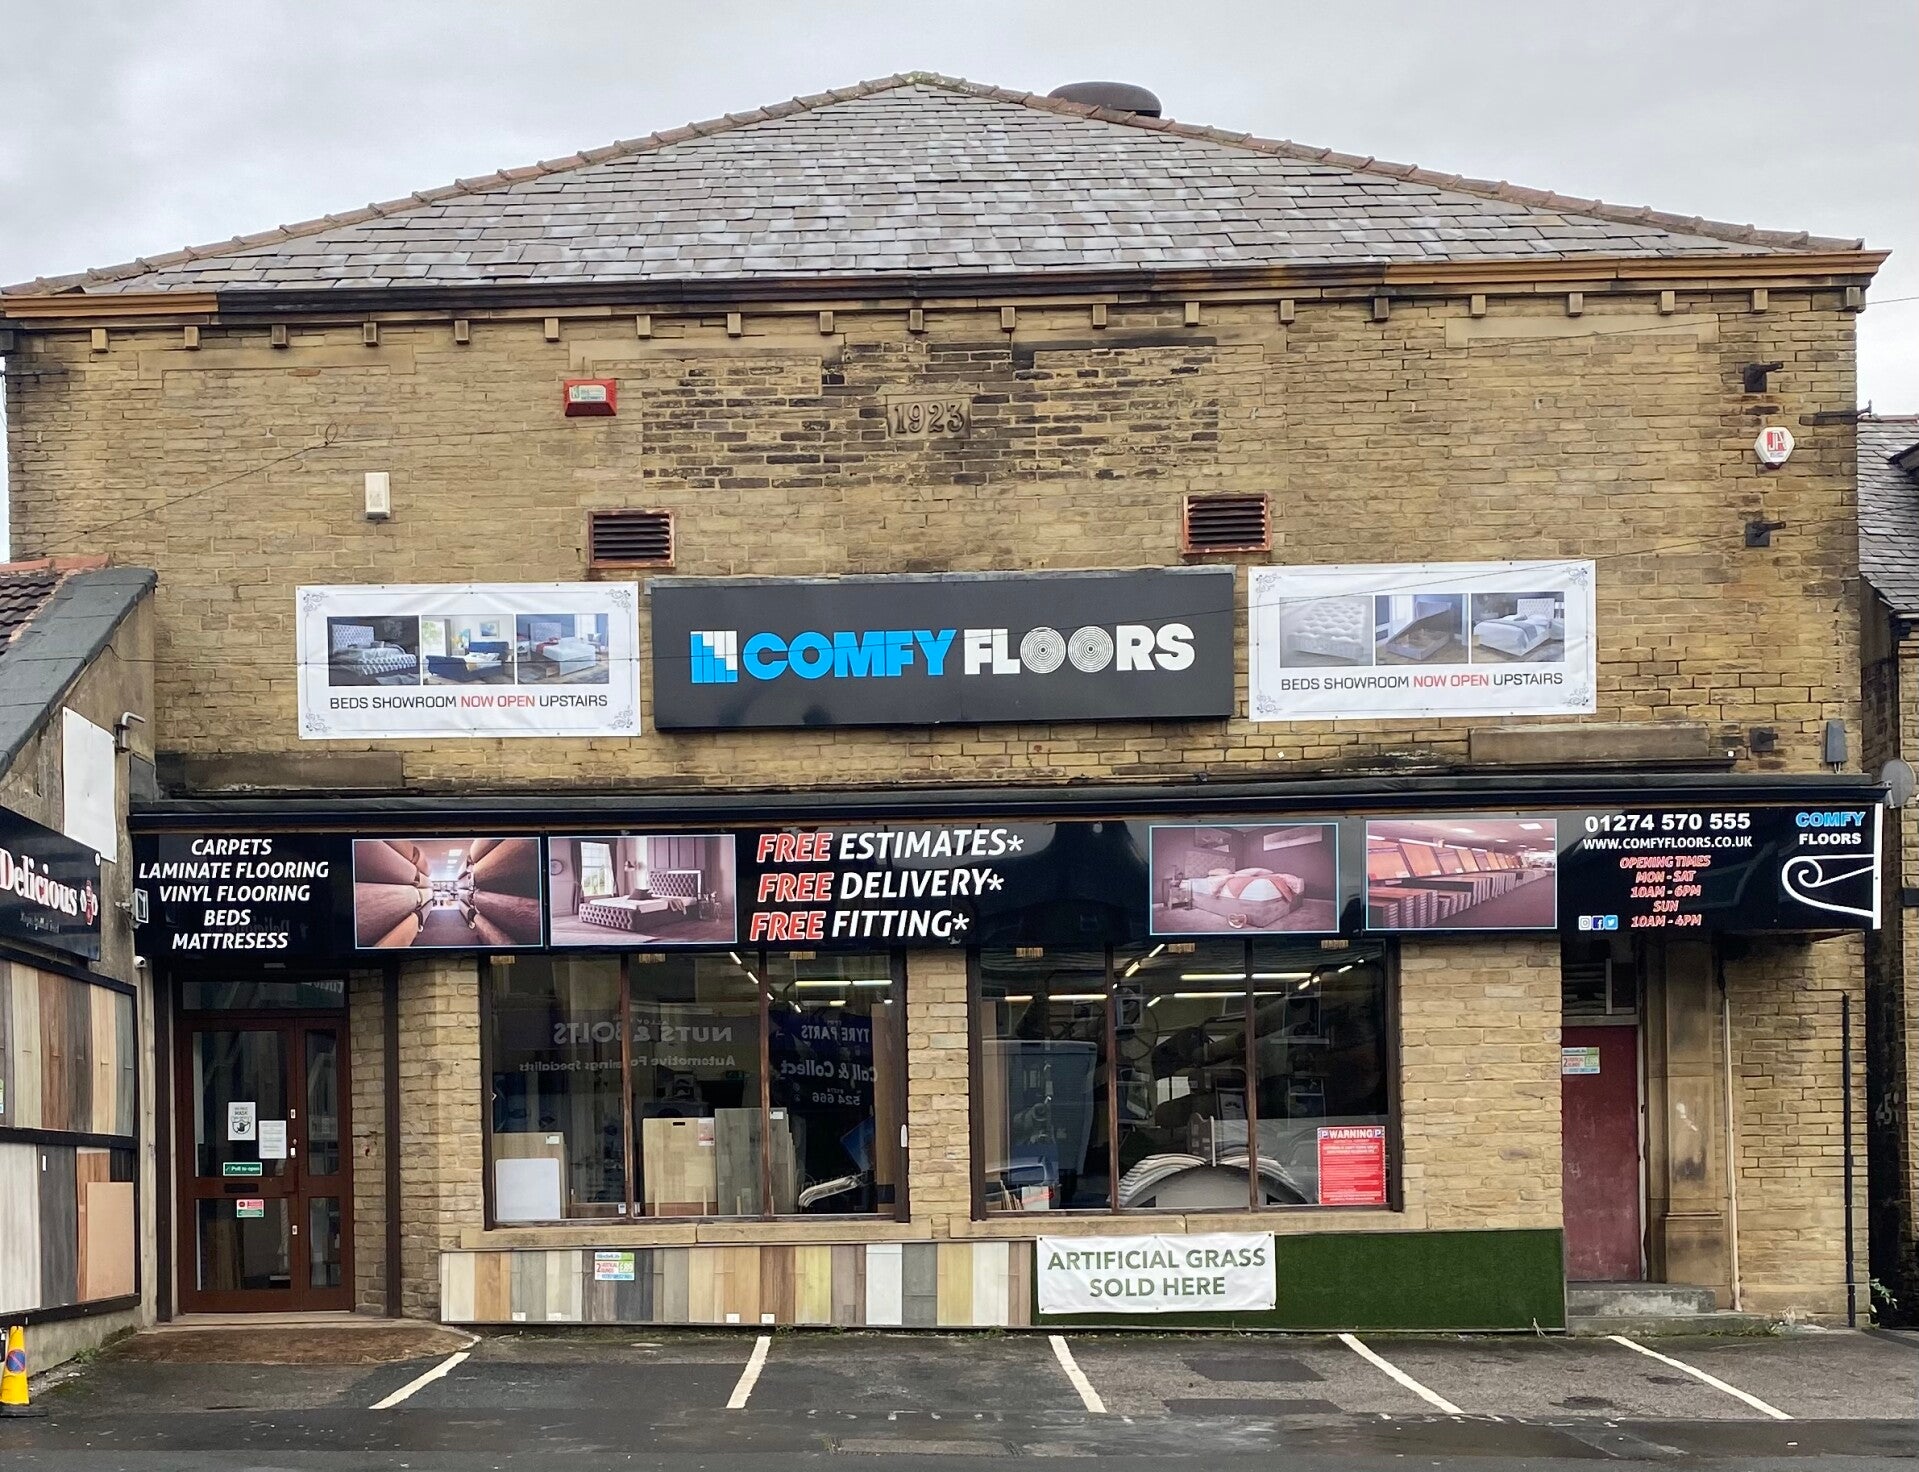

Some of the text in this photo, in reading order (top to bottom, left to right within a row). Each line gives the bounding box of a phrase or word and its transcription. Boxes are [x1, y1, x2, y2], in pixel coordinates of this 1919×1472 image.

[894, 402, 965, 433] 1923
[742, 623, 1197, 680] COMFY FLOORS
[1281, 672, 1563, 691] BEDS SHOWROOM NOW OPEN UPSTAIRS
[330, 694, 608, 710] BEDS SHOWROOM NOW OPEN UPSTAIRS
[1585, 812, 1751, 832] 01274 570 555
[1795, 811, 1866, 828] COMFY
[191, 838, 272, 856] CARPETS
[756, 832, 833, 863] FREE
[1583, 836, 1753, 850] WWW.COMFYFLOORS.CO.UK
[1798, 832, 1862, 846] FLOORS
[139, 861, 329, 879] LAMINATE FLOORING
[1619, 855, 1711, 869] OPENING TIMES
[0, 847, 78, 916] Delicious
[1635, 871, 1665, 884] MON
[1673, 870, 1697, 883] SAT
[159, 884, 311, 903] VINYL FLOORING
[757, 871, 834, 902] FREE
[1630, 886, 1666, 898] 10AM
[1674, 885, 1702, 897] 6PM
[1653, 900, 1679, 912] SUN
[203, 908, 251, 927] BEDS
[749, 910, 826, 942] FREE
[1630, 915, 1666, 928] 10AM
[1674, 914, 1702, 927] 4PM
[172, 932, 289, 950] MATTRESESS
[1329, 1129, 1372, 1139] WARNING
[1047, 1247, 1266, 1270] ARTIFICIAL GRASS
[1089, 1276, 1226, 1297] SOLD HERE
